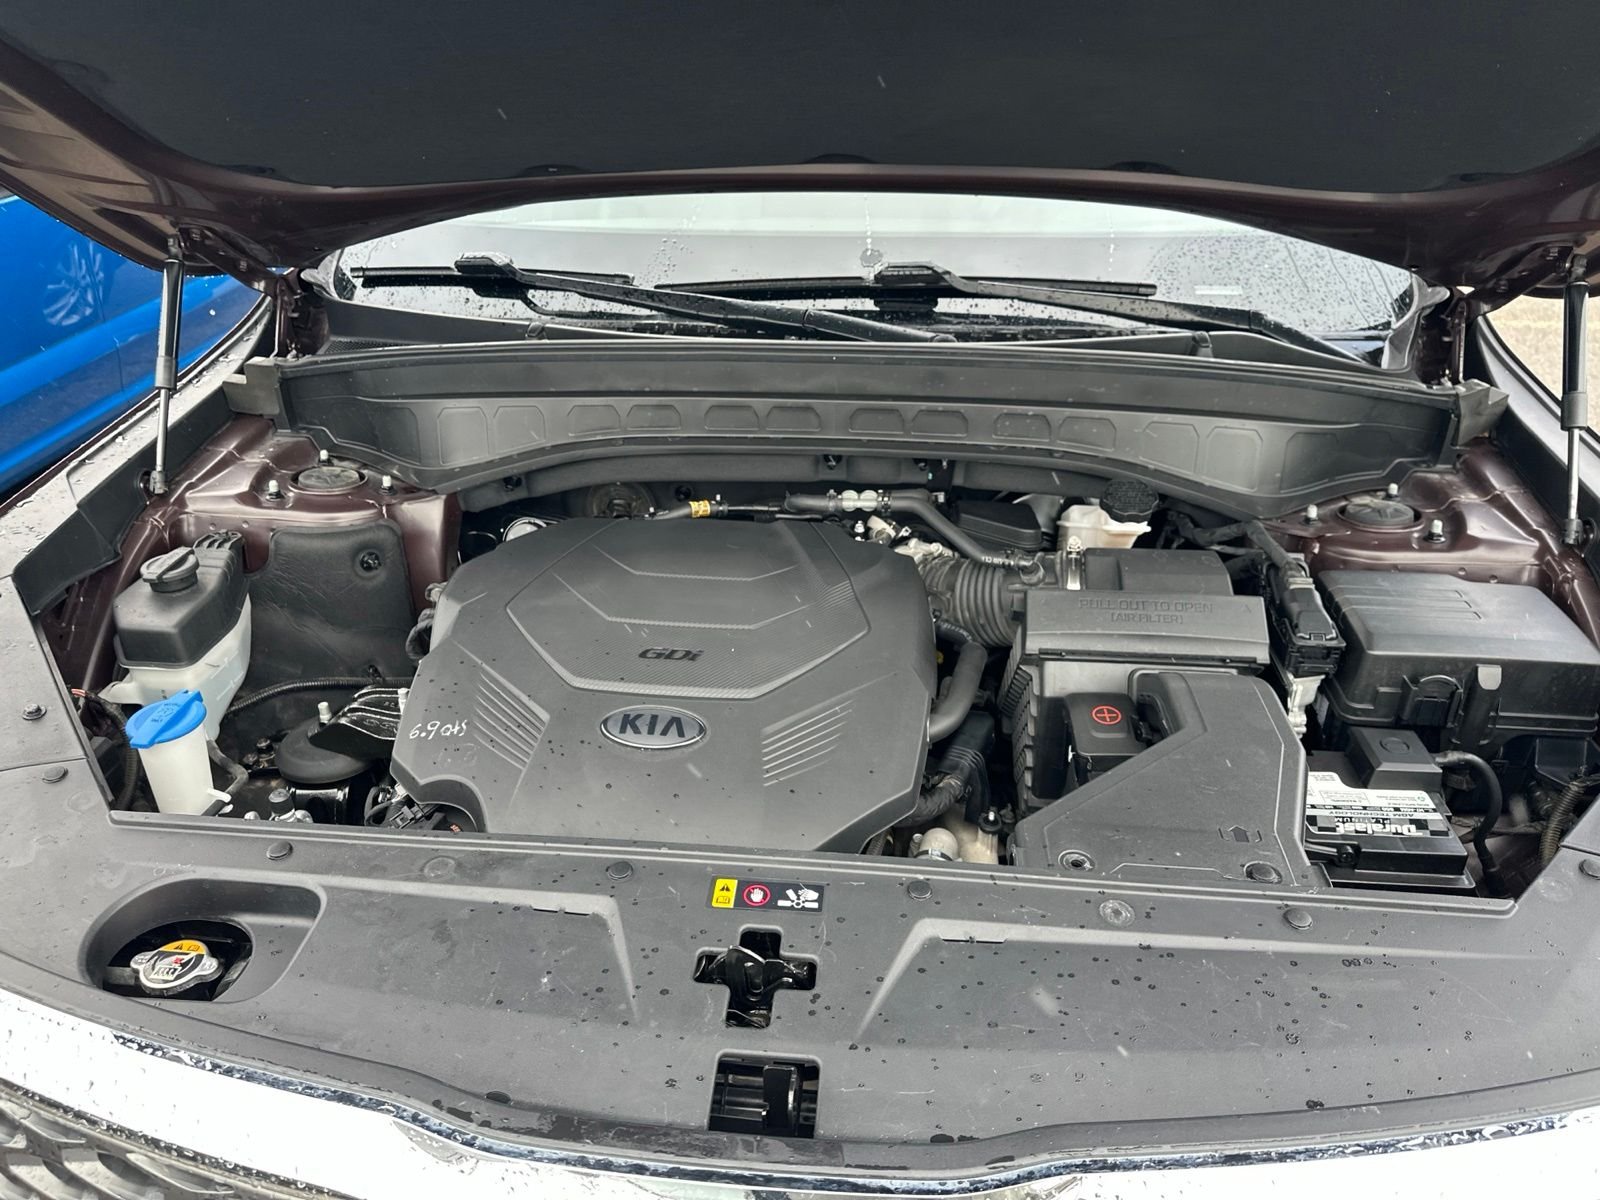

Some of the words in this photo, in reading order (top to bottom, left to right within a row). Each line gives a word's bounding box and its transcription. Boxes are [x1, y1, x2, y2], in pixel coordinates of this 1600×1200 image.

[1079, 598, 1115, 610] PULL
[1119, 599, 1147, 611] OUT
[1151, 600, 1170, 612] TO
[1174, 601, 1213, 614] OPEN
[638, 649, 704, 661] GDi
[409, 720, 440, 740] 6.9
[618, 714, 685, 738] KIA
[1335, 816, 1391, 824] PLATINUM
[1335, 822, 1423, 836] Duralast
